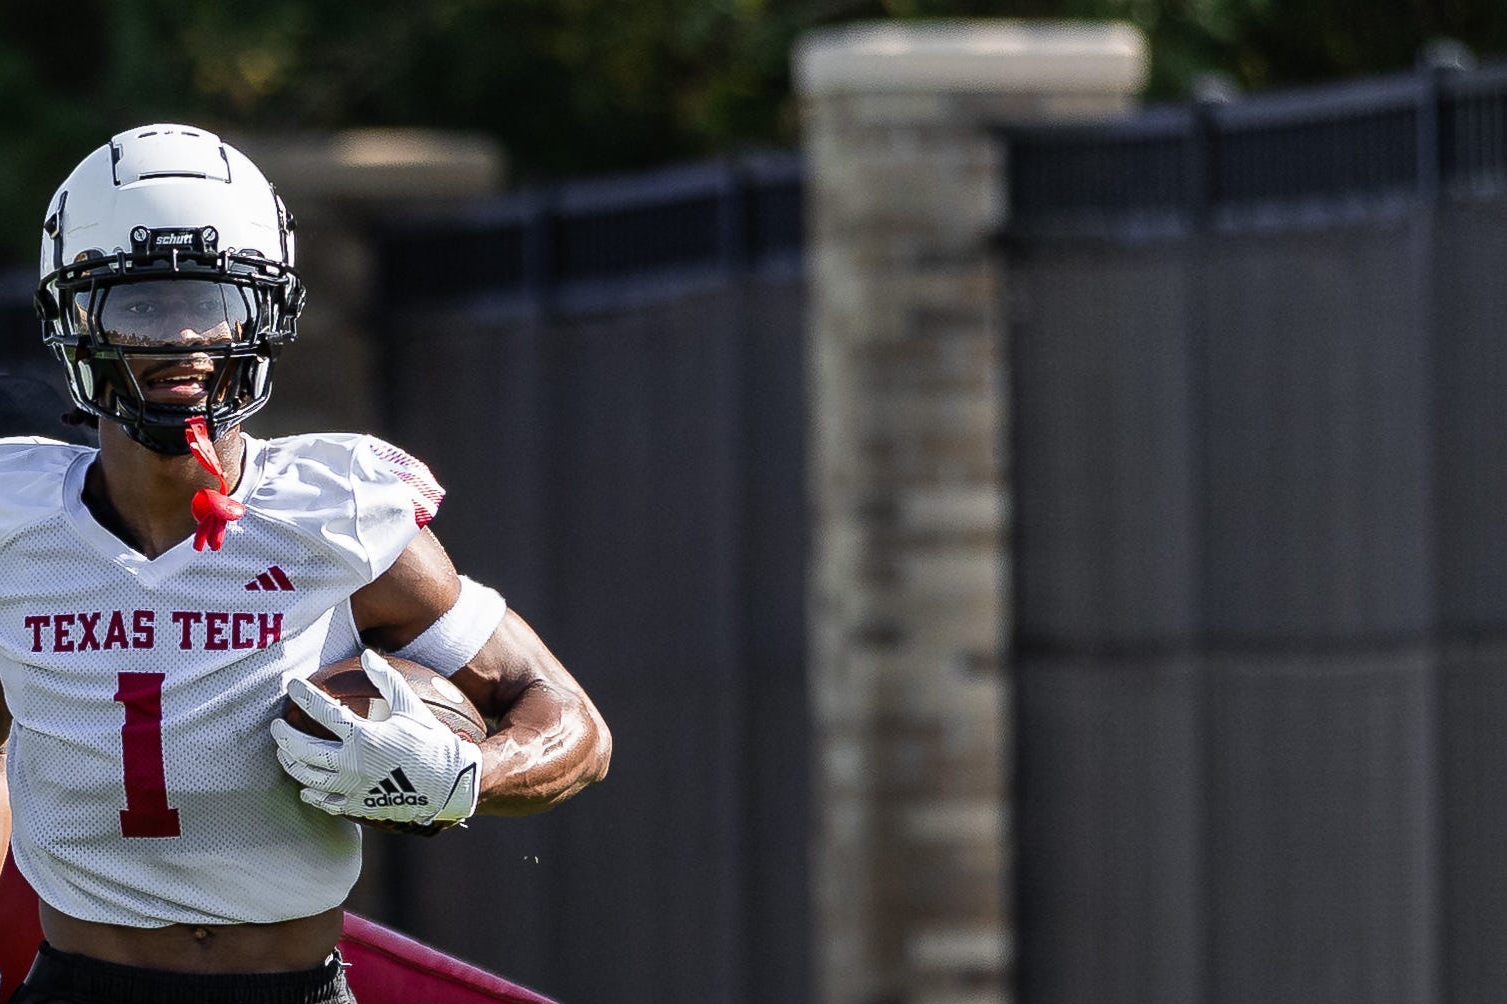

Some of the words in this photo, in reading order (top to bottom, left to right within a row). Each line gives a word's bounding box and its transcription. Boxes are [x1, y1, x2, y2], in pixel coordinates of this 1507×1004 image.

[155, 233, 194, 245] schutt
[24, 610, 155, 652] TEXAS
[171, 611, 284, 651] TECH
[113, 672, 181, 838] 1
[363, 791, 429, 808] adidas
